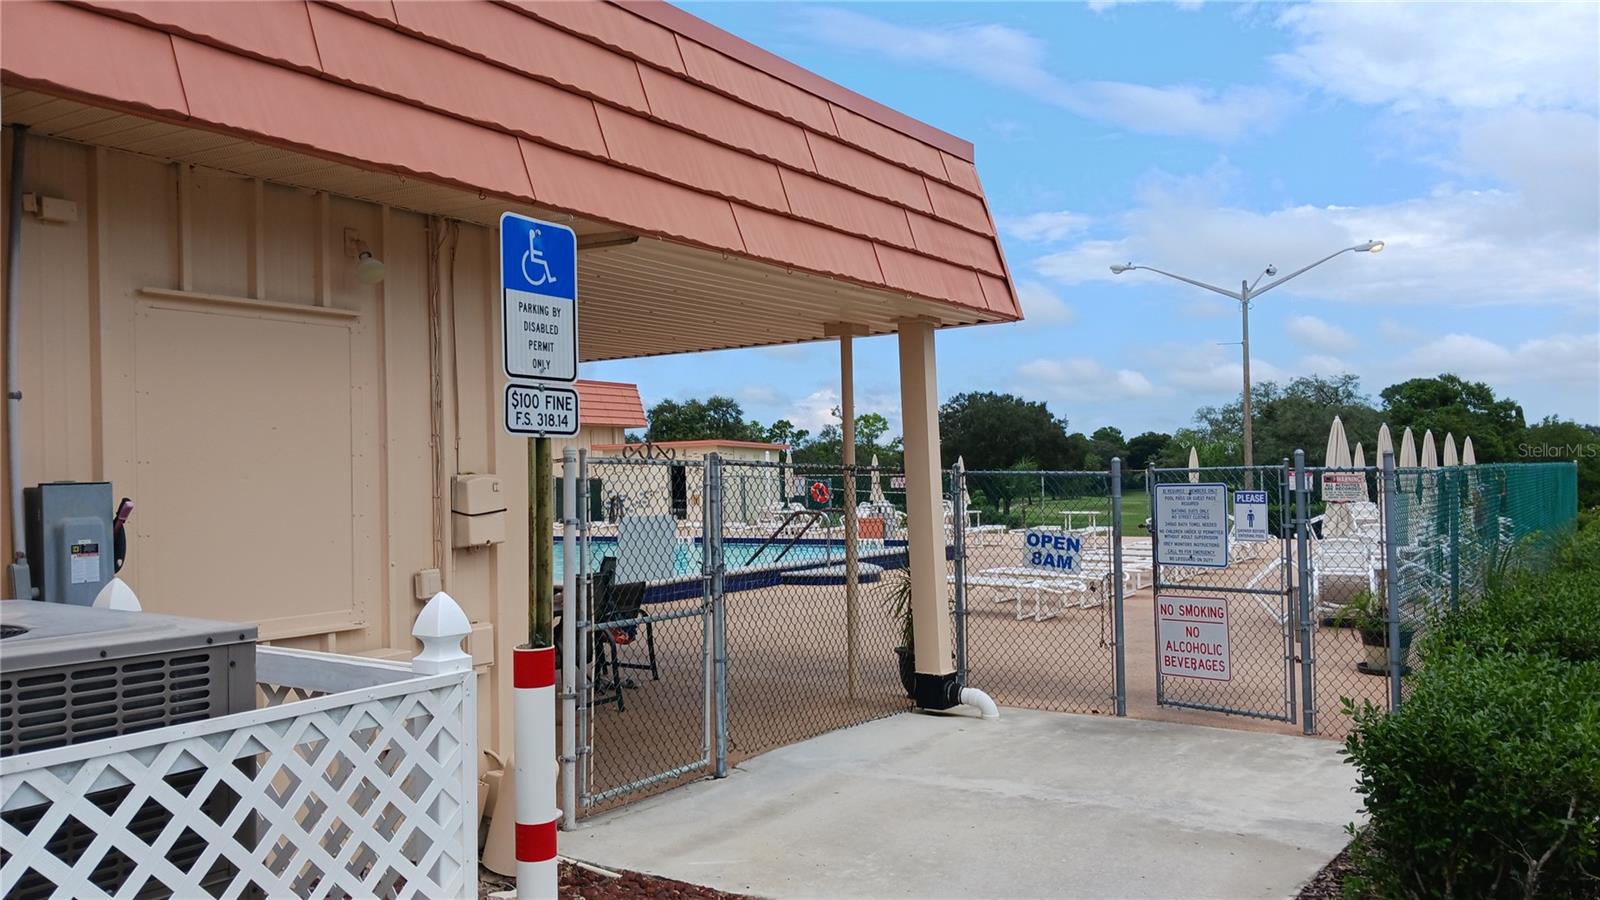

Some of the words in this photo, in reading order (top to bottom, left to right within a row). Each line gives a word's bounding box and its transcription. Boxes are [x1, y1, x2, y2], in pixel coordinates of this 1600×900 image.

[519, 301, 549, 316] PARKING
[552, 307, 561, 318] BY
[524, 320, 559, 335] DISABLED
[528, 339, 555, 352] PERMIT
[532, 358, 551, 370] ONLY
[511, 390, 540, 410] $100
[545, 395, 573, 411] FINE
[515, 411, 533, 426] F.S.
[537, 413, 569, 427] 318.14
[1236, 493, 1265, 503] PLEASE
[1027, 533, 1080, 552] OPEN
[1031, 552, 1073, 569] 8AM
[1160, 604, 1174, 615] NO
[1179, 604, 1224, 619] SMOKING
[1185, 626, 1200, 638] NO
[1166, 640, 1223, 656] ALCOHOLIC
[1164, 655, 1226, 672] BEVERAGES
